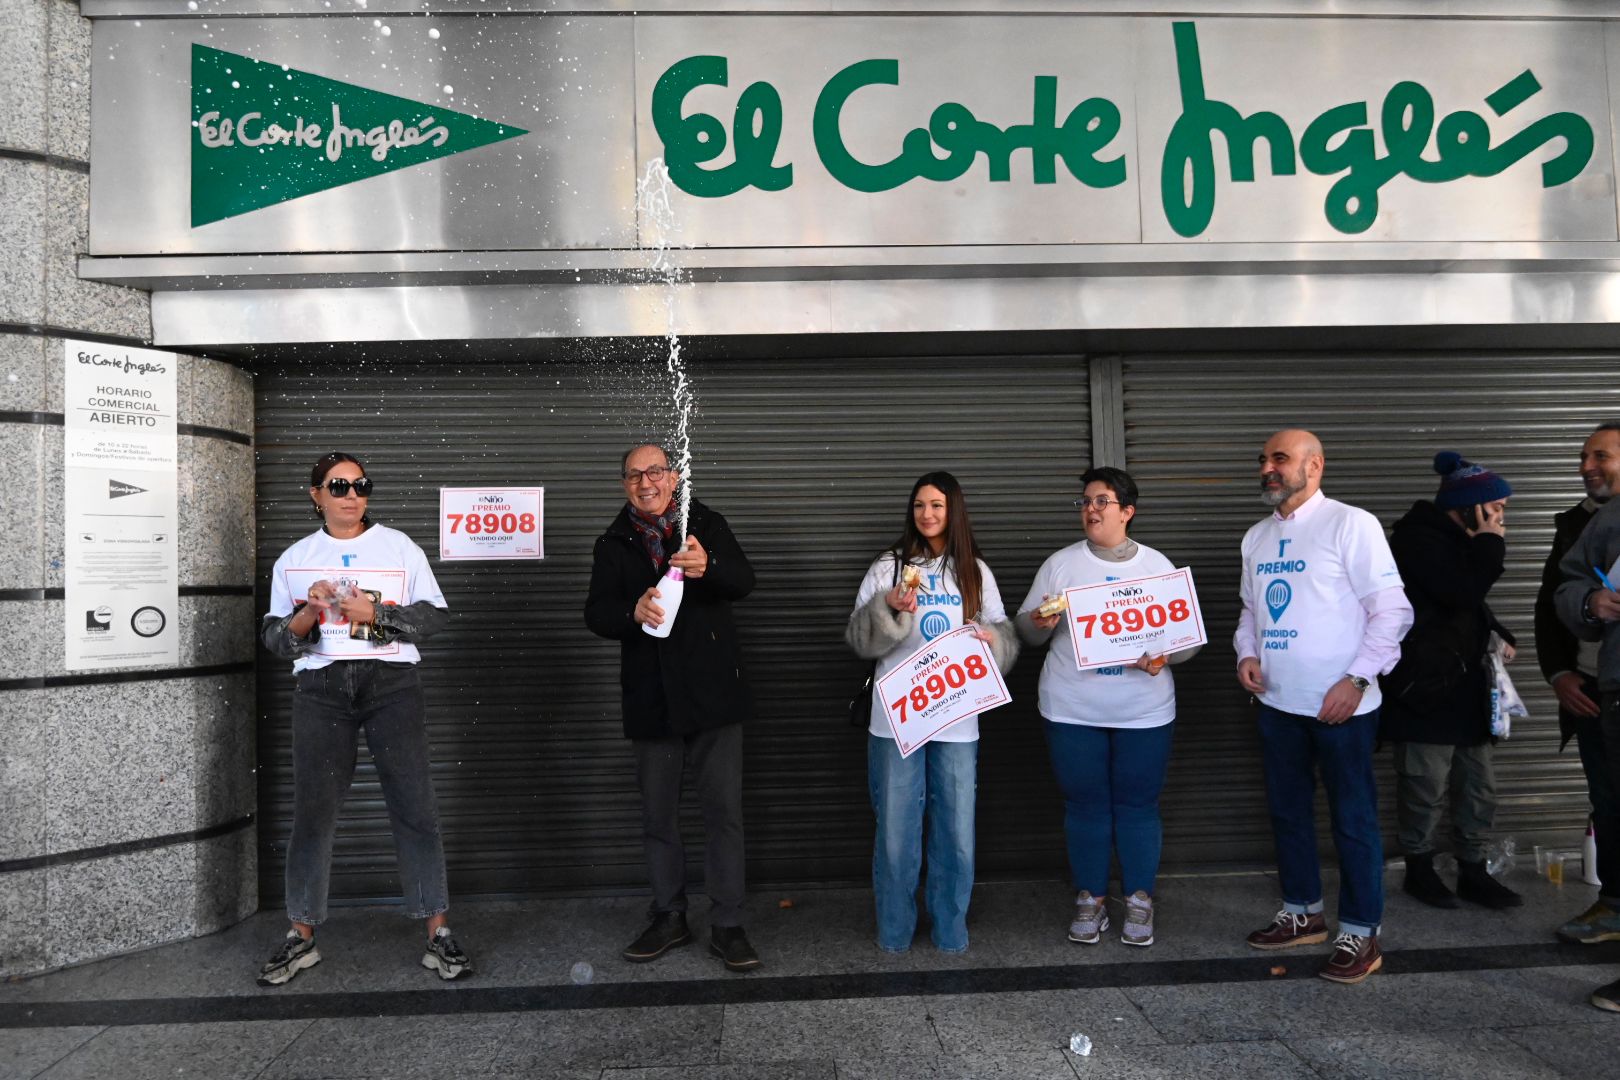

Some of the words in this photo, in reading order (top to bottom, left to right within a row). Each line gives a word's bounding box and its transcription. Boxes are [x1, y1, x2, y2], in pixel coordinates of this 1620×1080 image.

[199, 111, 234, 147] El
[236, 112, 322, 148] Corte
[326, 104, 448, 162] Inglés
[652, 55, 793, 198] El
[813, 59, 1127, 192] Corte
[1161, 21, 1594, 237] Inglés
[77, 352, 91, 364] El
[92, 354, 122, 368] Corte
[123, 355, 166, 375] Inglés
[96, 386, 152, 399] HORARIO
[88, 397, 161, 412] COMERCIAL
[89, 412, 156, 427] ABIERTO
[484, 495, 504, 504] Niño
[477, 504, 512, 512] PREMIO
[446, 512, 536, 535] 78908
[1256, 560, 1306, 575] PREMIO
[1119, 587, 1143, 597] Niño
[916, 594, 962, 607] REMIO
[1113, 595, 1154, 607] PREMIO
[1076, 599, 1190, 638] 78908
[1109, 634, 1144, 643] VENDIDO
[1265, 639, 1289, 650] AQUÍ
[919, 651, 938, 667] Niño
[917, 655, 950, 681] PREMIO
[891, 654, 988, 725] 78908
[921, 698, 949, 718] VENDIDO
